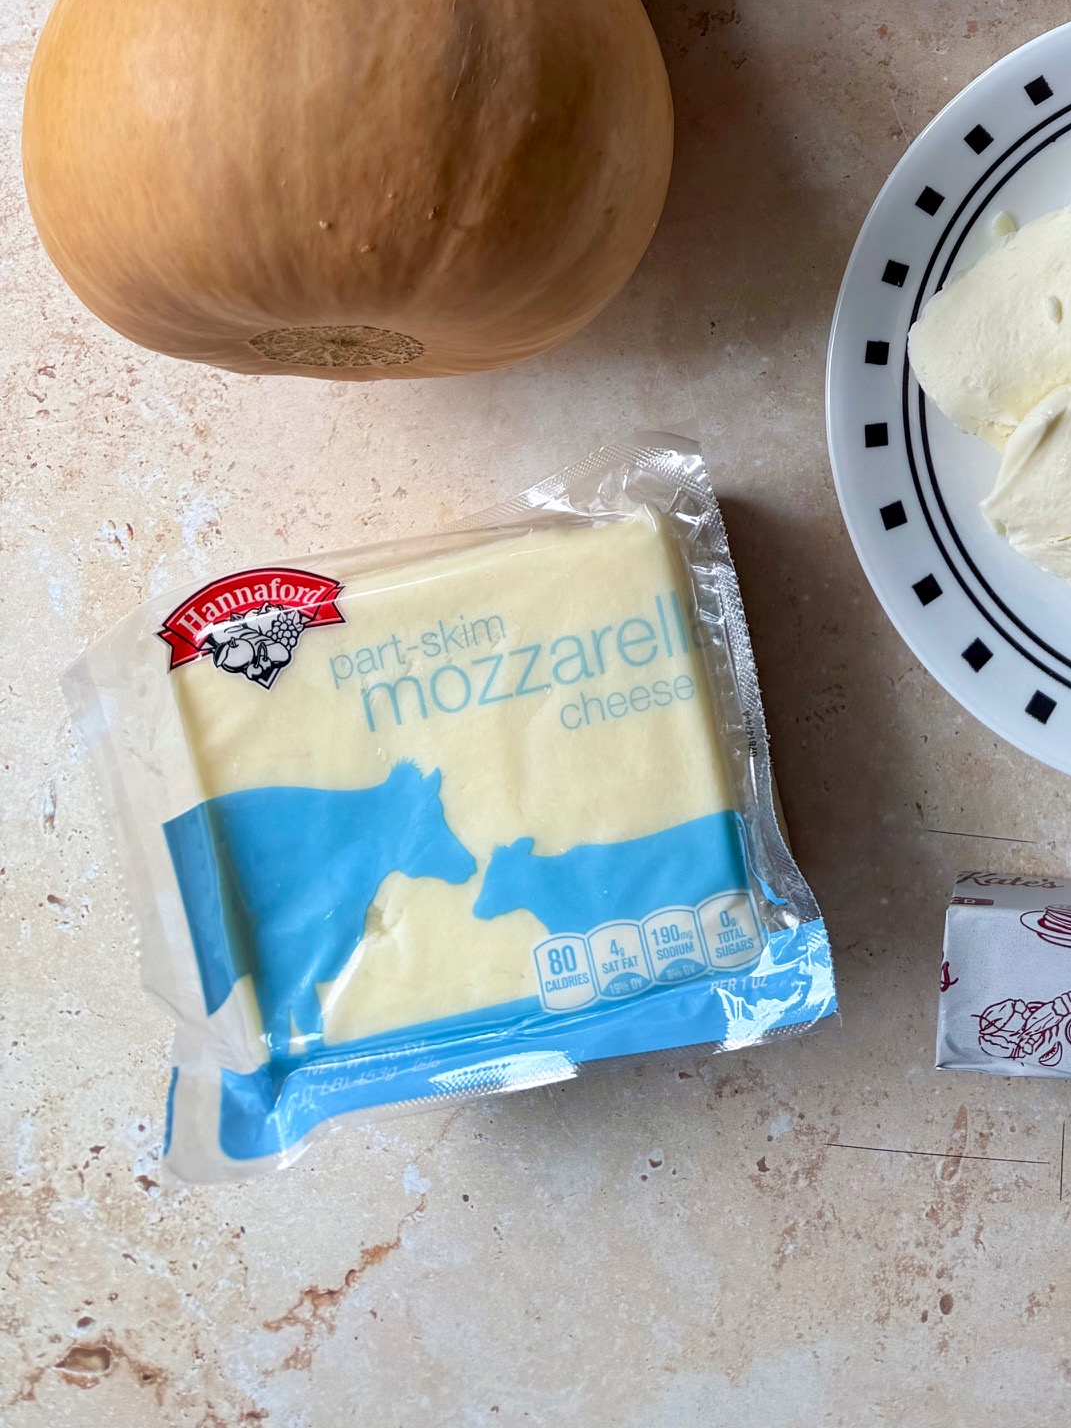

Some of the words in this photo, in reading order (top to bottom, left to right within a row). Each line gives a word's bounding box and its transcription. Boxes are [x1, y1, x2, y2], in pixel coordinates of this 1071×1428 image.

[176, 578, 327, 642] Hannaford
[329, 615, 506, 689] part-skim
[560, 675, 695, 730] cheese
[956, 871, 1064, 889] Kate's
[717, 927, 746, 944] TOTAL
[657, 941, 695, 960] SODIUM
[715, 938, 755, 959] SUGARS
[547, 945, 577, 975] 80
[602, 959, 619, 974] SAT
[621, 956, 638, 970] FAT
[545, 973, 590, 993] CALORIES
